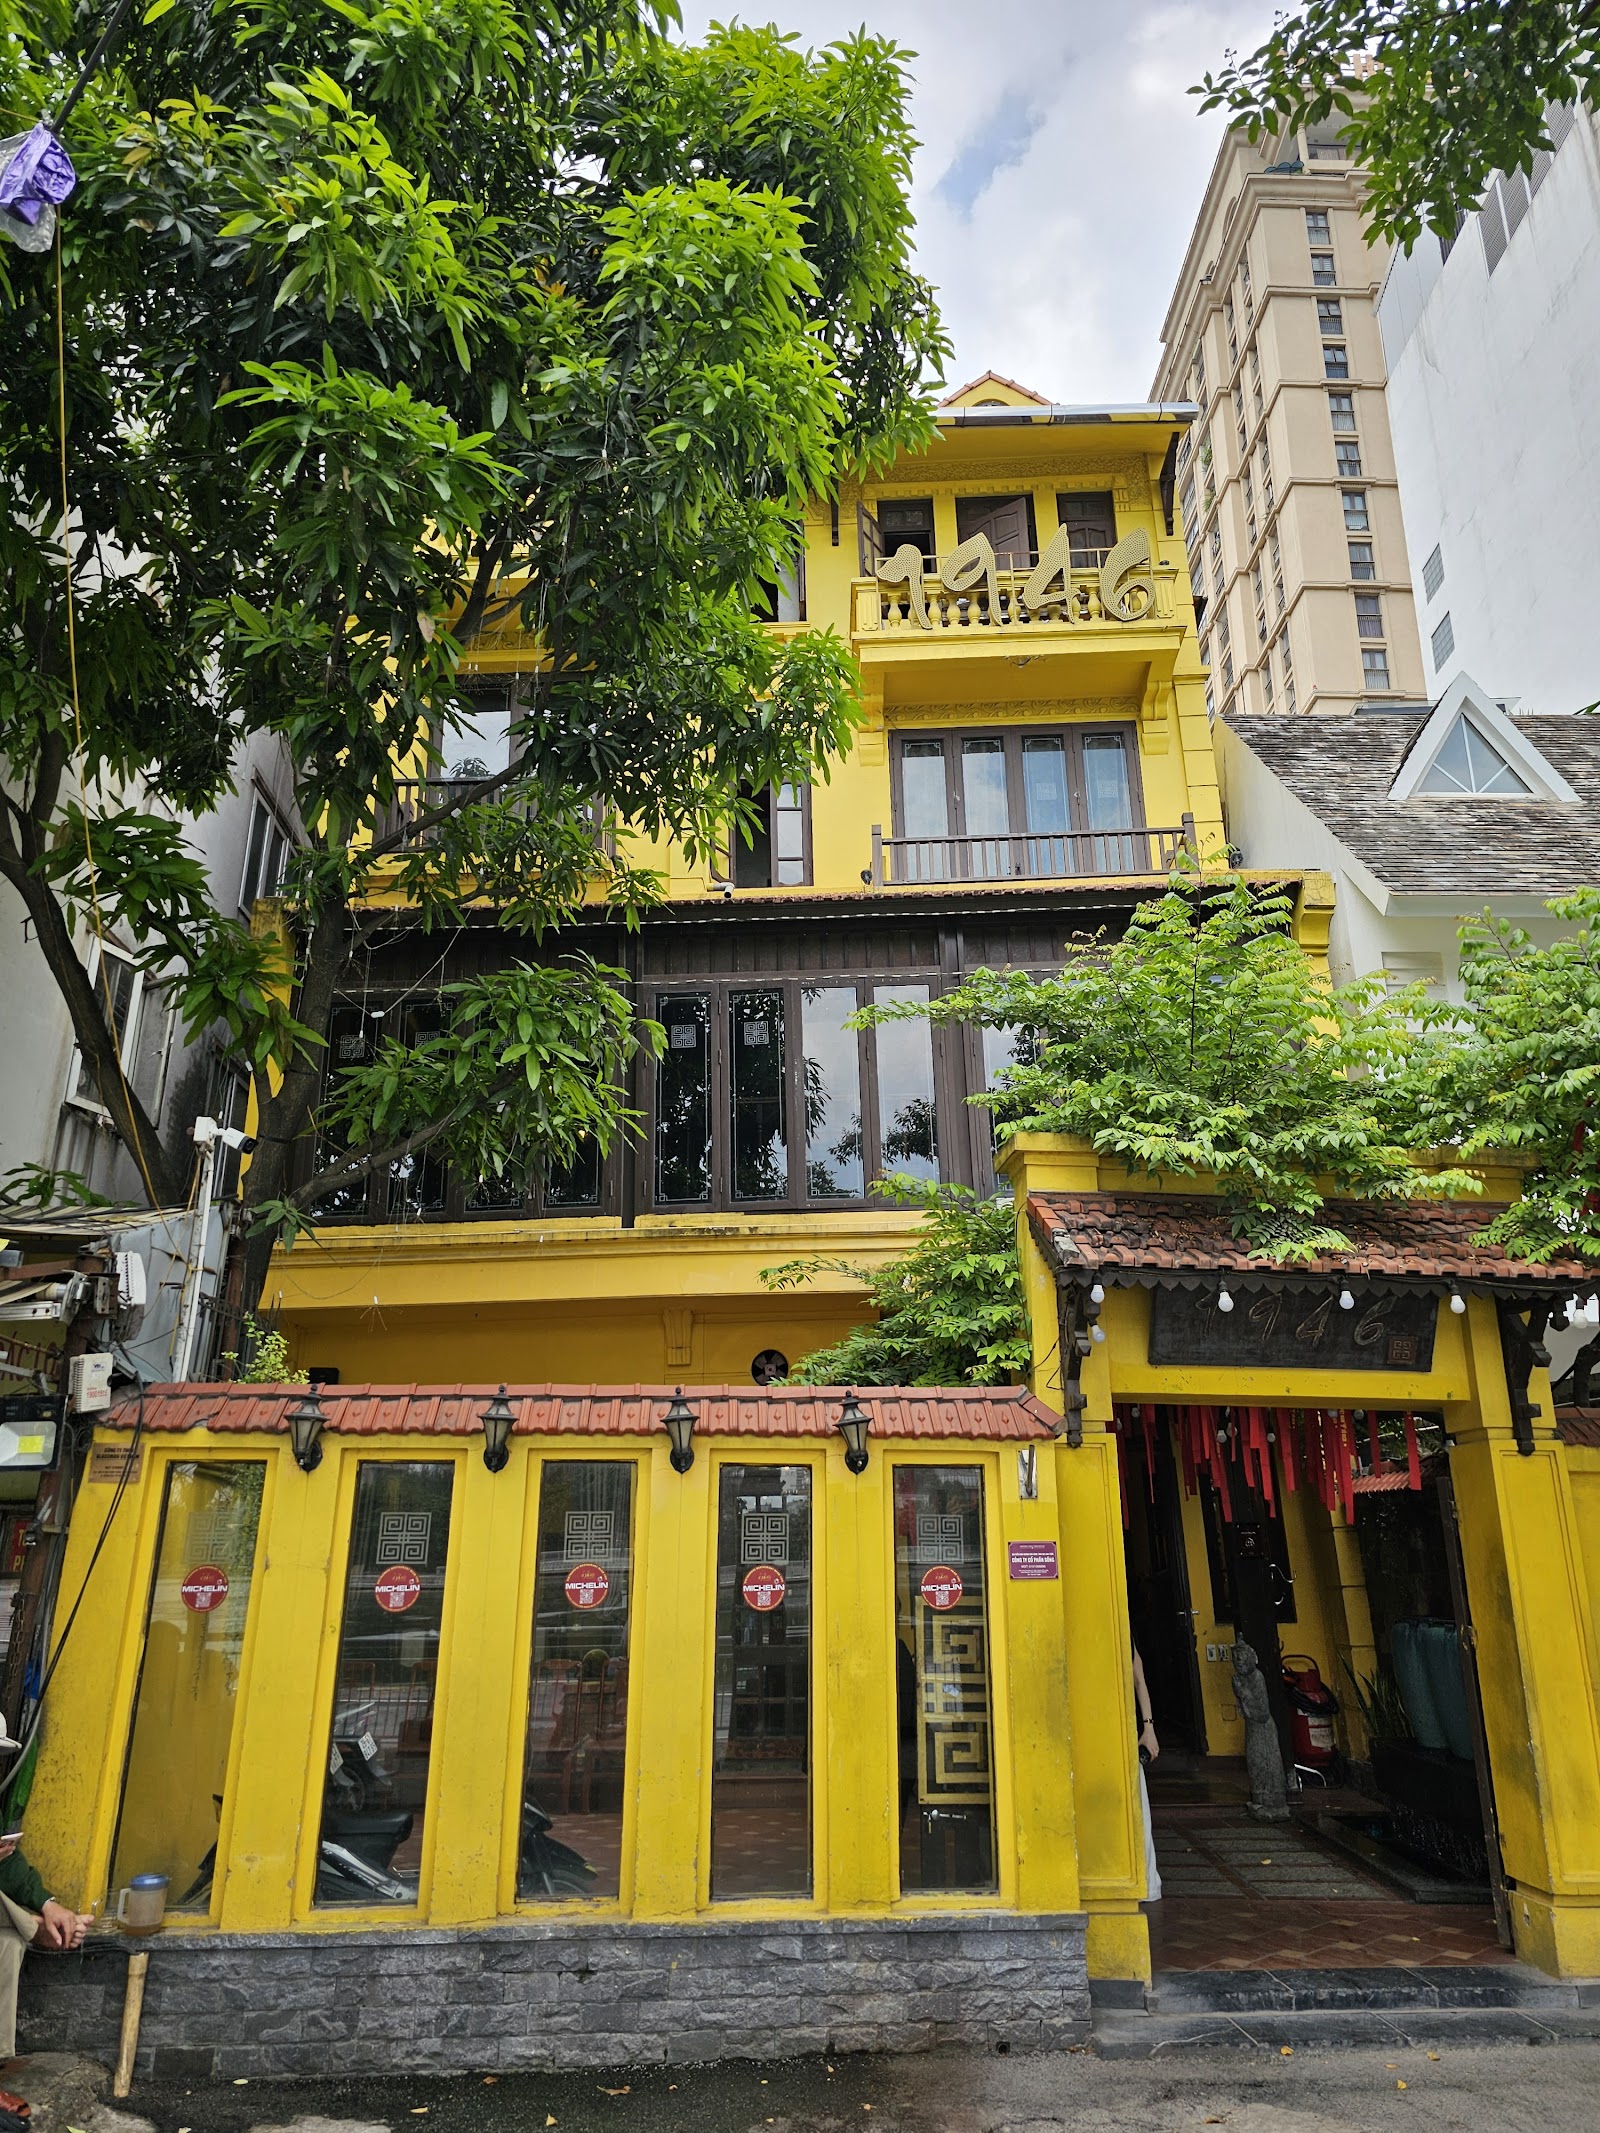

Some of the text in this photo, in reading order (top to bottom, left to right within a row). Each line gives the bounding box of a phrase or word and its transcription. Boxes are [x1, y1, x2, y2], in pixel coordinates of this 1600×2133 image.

[876, 523, 1156, 630] 1946
[1195, 1290, 1398, 1347] 1946
[182, 1585, 228, 1593] MICHELIN
[375, 1584, 421, 1593] MICHELIN
[565, 1582, 609, 1590] MICHELIN
[743, 1584, 786, 1592] MICHELIN
[921, 1584, 963, 1592] MICHELIN
